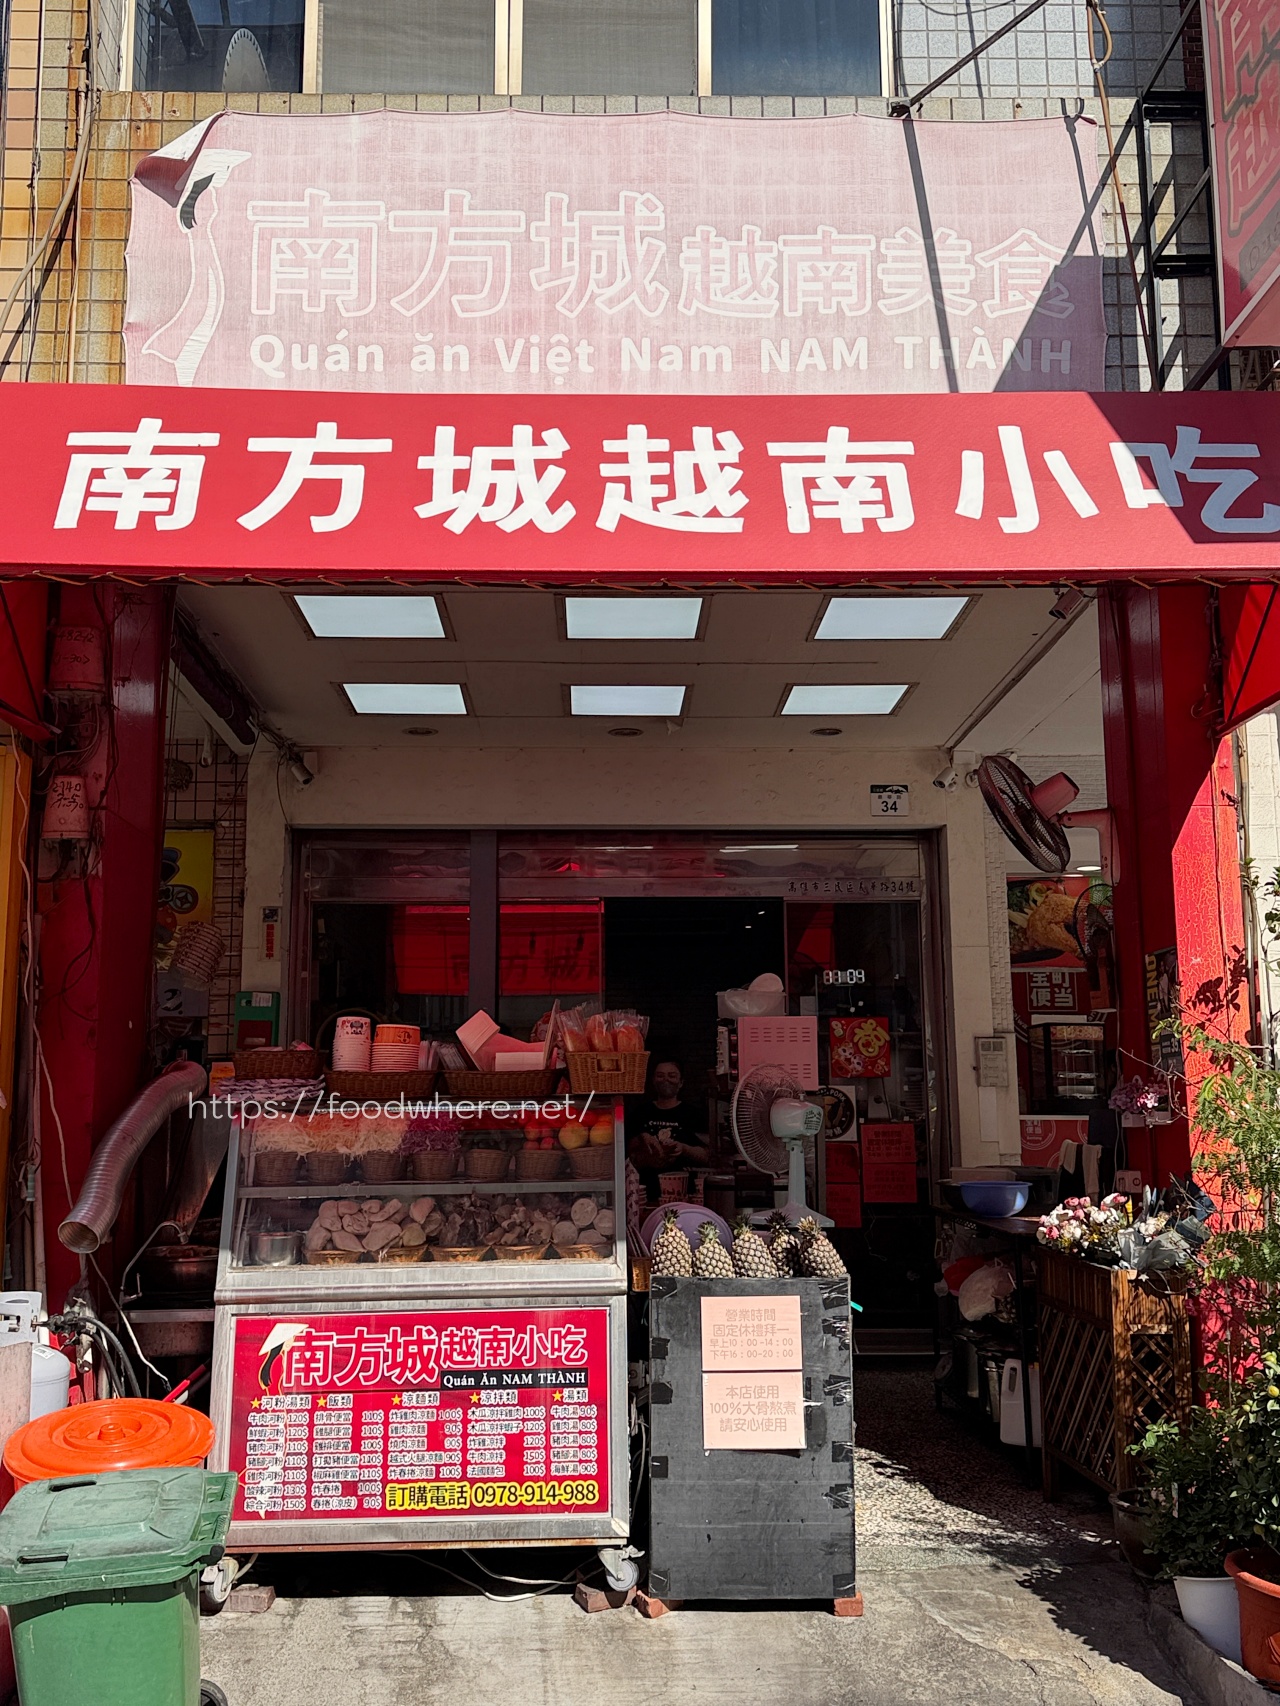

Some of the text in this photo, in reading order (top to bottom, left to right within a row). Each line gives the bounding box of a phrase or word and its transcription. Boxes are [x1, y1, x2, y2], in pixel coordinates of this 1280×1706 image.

[249, 326, 1072, 386] Quán ăn Việt Nam NAM THÀNH
[53, 417, 1280, 536] 南方城越南小吃
[881, 800, 898, 812] 34
[1030, 987, 1073, 1007] 便当
[725, 1309, 776, 1322] 營業時間
[713, 1324, 790, 1337] 固定休禮拜一
[283, 1324, 588, 1387] 南方城越南小吃
[443, 1370, 586, 1387] Quán Ăn NAM THÀNH
[563, 1389, 587, 1401] 湯類
[725, 1385, 779, 1399] 本店使用
[262, 1396, 310, 1408] 河粉湯類
[328, 1395, 352, 1407] 飯類
[481, 1391, 517, 1404] 涼拌類
[525, 1408, 545, 1417] 100$
[709, 1401, 796, 1415] 100%大骨熬煮
[289, 1413, 308, 1423] 120$
[362, 1412, 383, 1421] 110$
[438, 1410, 462, 1420] 100$
[525, 1422, 545, 1432] 120$
[581, 1421, 597, 1431] 80$
[720, 1418, 787, 1432] 請安心使用
[288, 1428, 307, 1437] 120$
[362, 1426, 382, 1436] 110$
[362, 1440, 382, 1450] 100$
[524, 1437, 545, 1446] 120$
[581, 1436, 597, 1445] 80$
[287, 1442, 307, 1451] 110$
[361, 1454, 382, 1464] 110$
[446, 1453, 461, 1462] 90$
[581, 1450, 597, 1459] 80$
[286, 1456, 306, 1466] 110$
[286, 1470, 306, 1480] 110$
[361, 1469, 381, 1478] 110$
[440, 1467, 461, 1477] 100$
[524, 1466, 545, 1475] 100$
[389, 1483, 597, 1506] 訂購電話 0978-914-988
[285, 1499, 305, 1509] 150$
